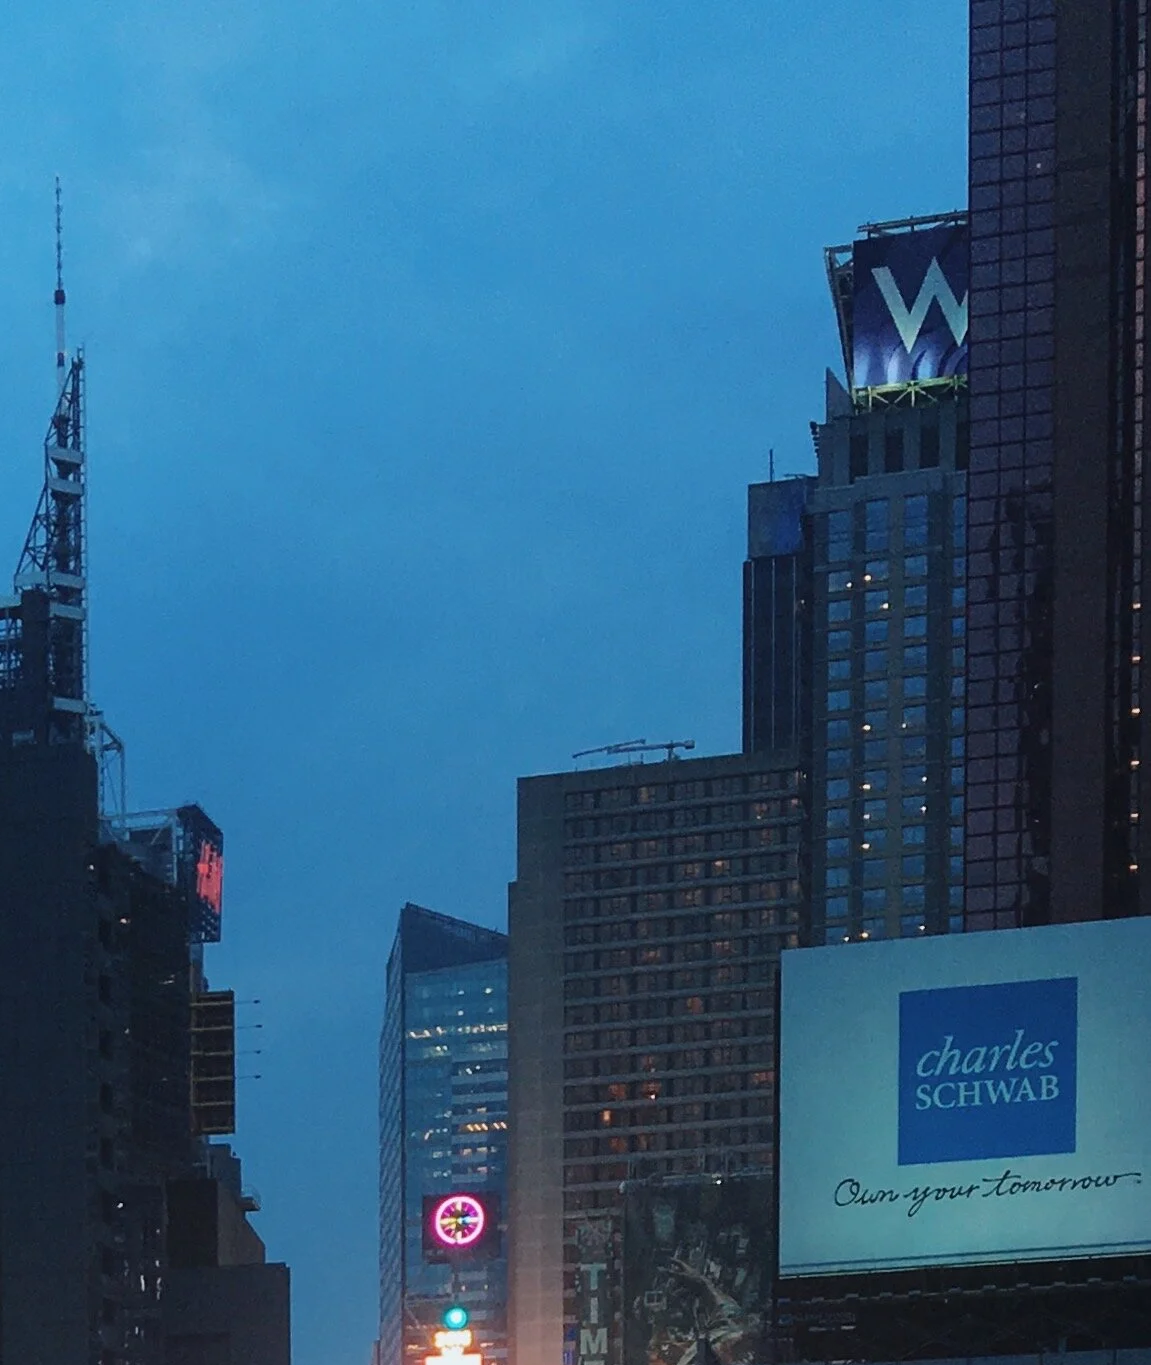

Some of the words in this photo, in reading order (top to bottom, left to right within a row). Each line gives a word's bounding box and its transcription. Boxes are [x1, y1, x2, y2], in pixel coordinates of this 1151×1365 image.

[872, 257, 968, 354] W
[916, 1030, 1059, 1077] charles
[915, 1075, 1059, 1110] SCHWAB
[834, 1177, 901, 1207] Own
[903, 1184, 980, 1217] your
